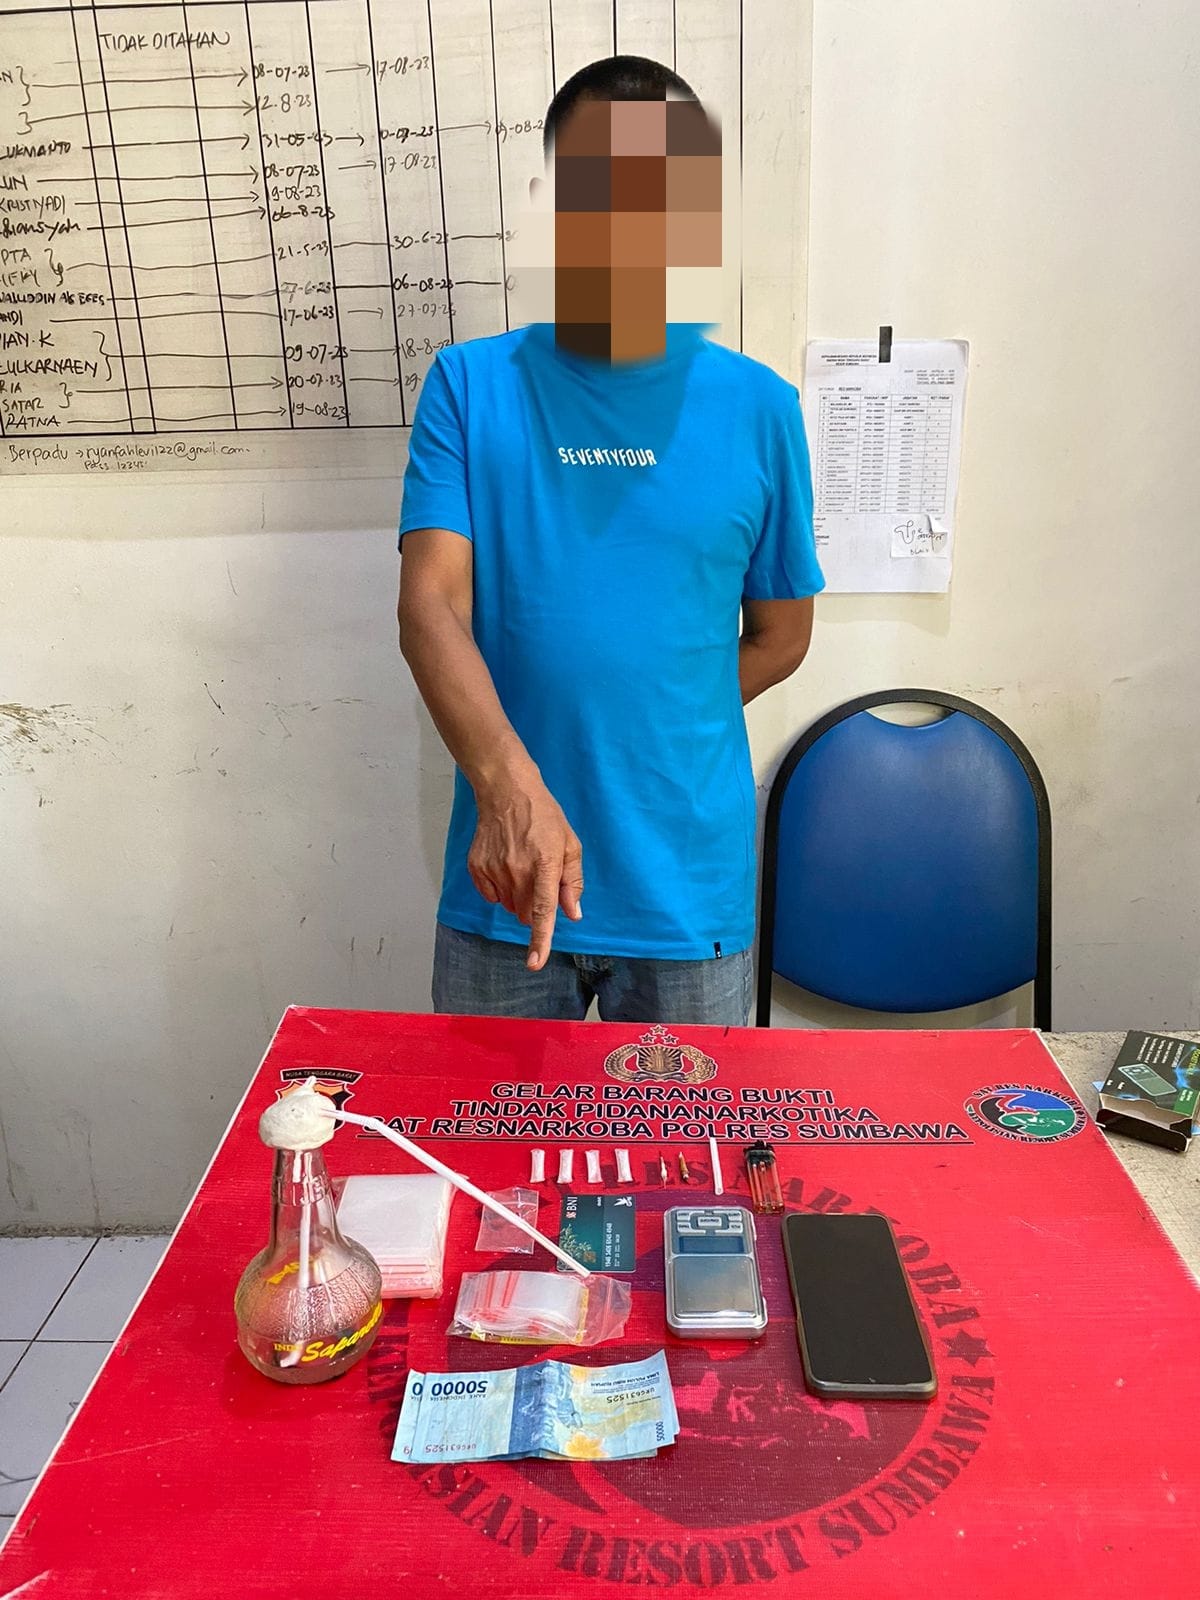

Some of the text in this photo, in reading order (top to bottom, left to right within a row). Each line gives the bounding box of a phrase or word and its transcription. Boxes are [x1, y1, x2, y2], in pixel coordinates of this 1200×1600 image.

[100, 31, 230, 53] TIDAK DITAHAN
[5, 413, 61, 430] RATNA
[9, 443, 68, 466] Berpadu
[558, 446, 657, 467] SEVENTYFOUR
[491, 1083, 835, 1105] GELAR BARANG BUKTI
[450, 1100, 880, 1122] TINDAK PIDANANARKOTIKA
[430, 1117, 655, 1138] RESNARKOBA
[662, 1121, 790, 1139] POLRES
[797, 1121, 969, 1140] SUMBAWA
[566, 1196, 578, 1211] BNI
[431, 1380, 489, 1397] 50000
[656, 1420, 666, 1442] 50000
[556, 1522, 811, 1590] RESORT
[818, 1375, 996, 1559] SUMBAWA
